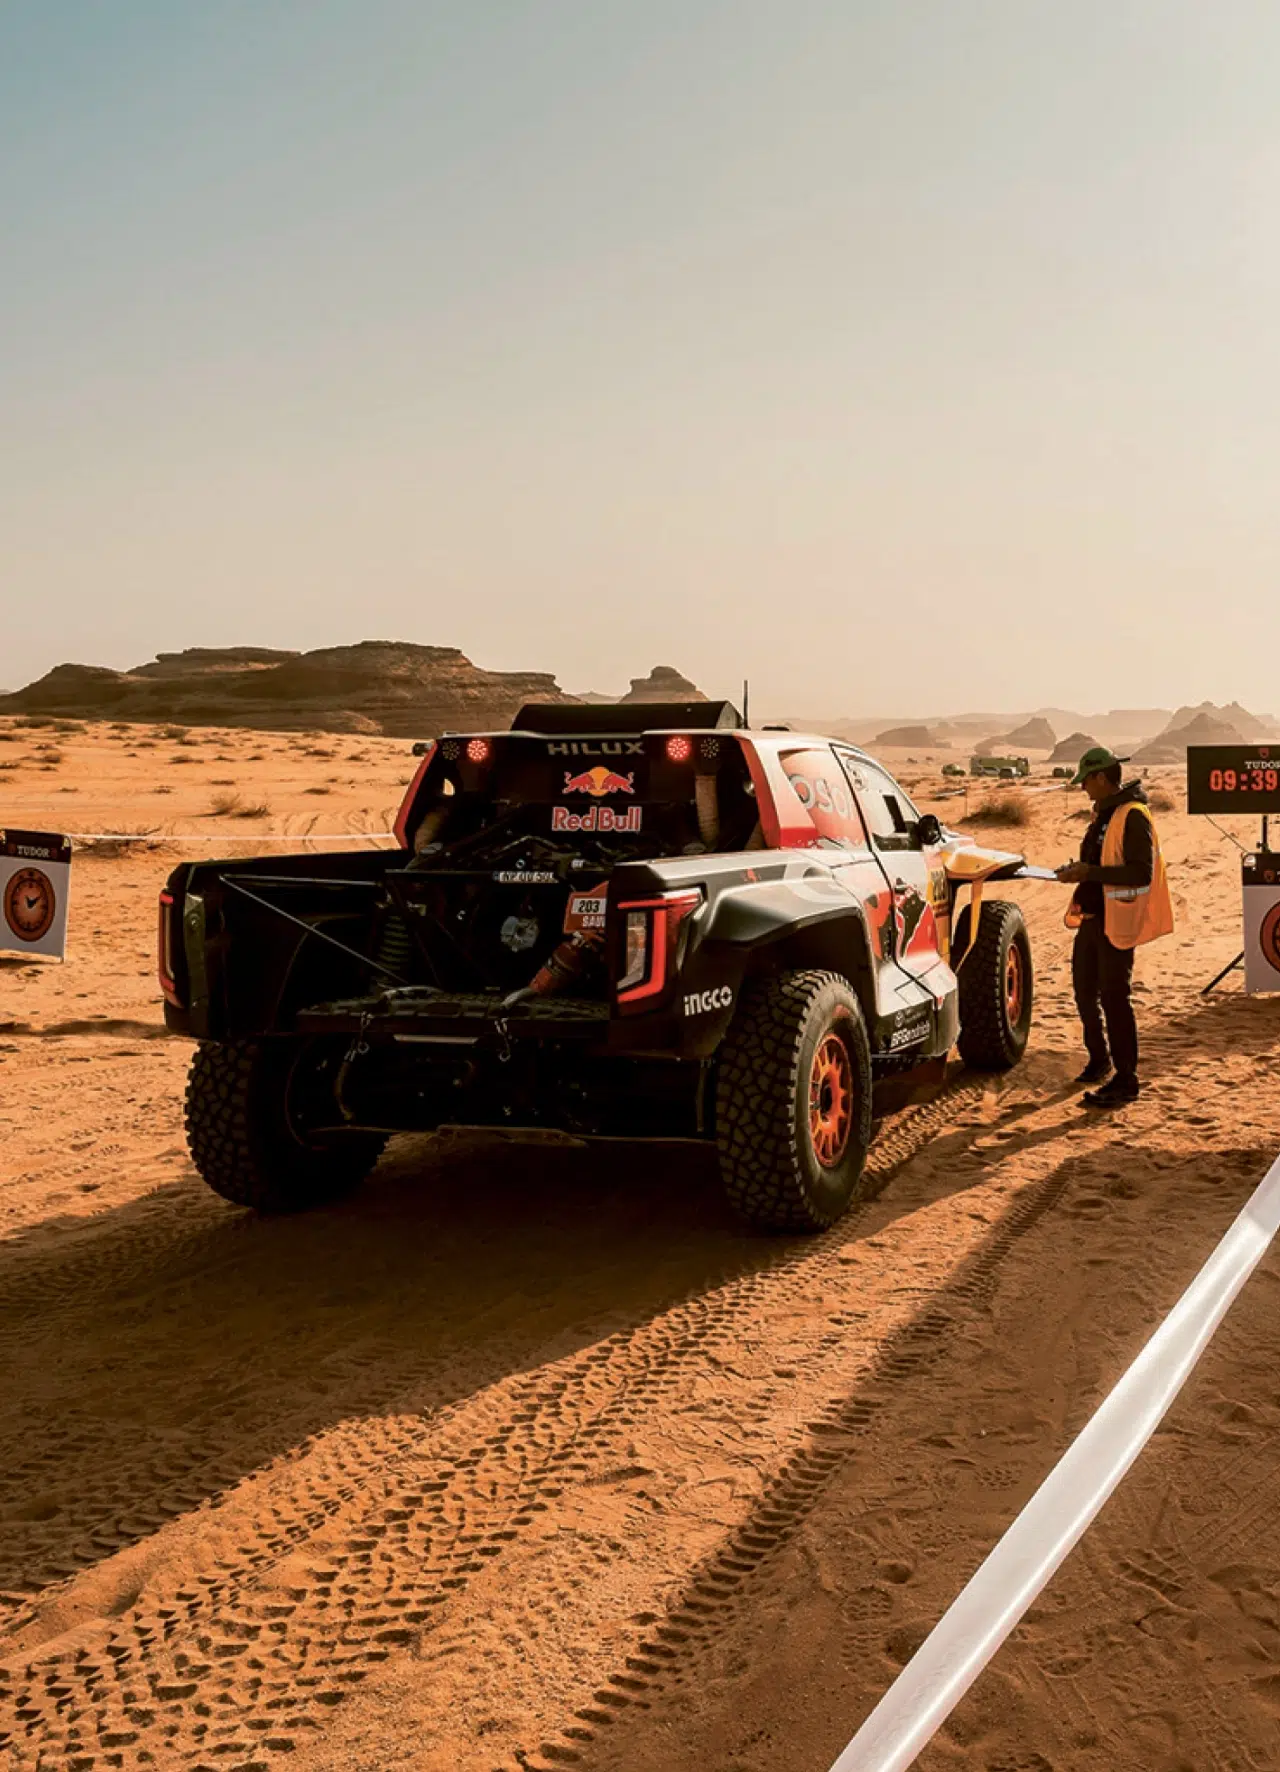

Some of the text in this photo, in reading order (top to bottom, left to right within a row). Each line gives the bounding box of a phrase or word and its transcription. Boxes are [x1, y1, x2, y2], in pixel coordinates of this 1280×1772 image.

[547, 742, 645, 755] HILUX
[552, 806, 642, 832] Red Bull
[17, 844, 50, 858] TUDOR
[577, 900, 600, 913] 203
